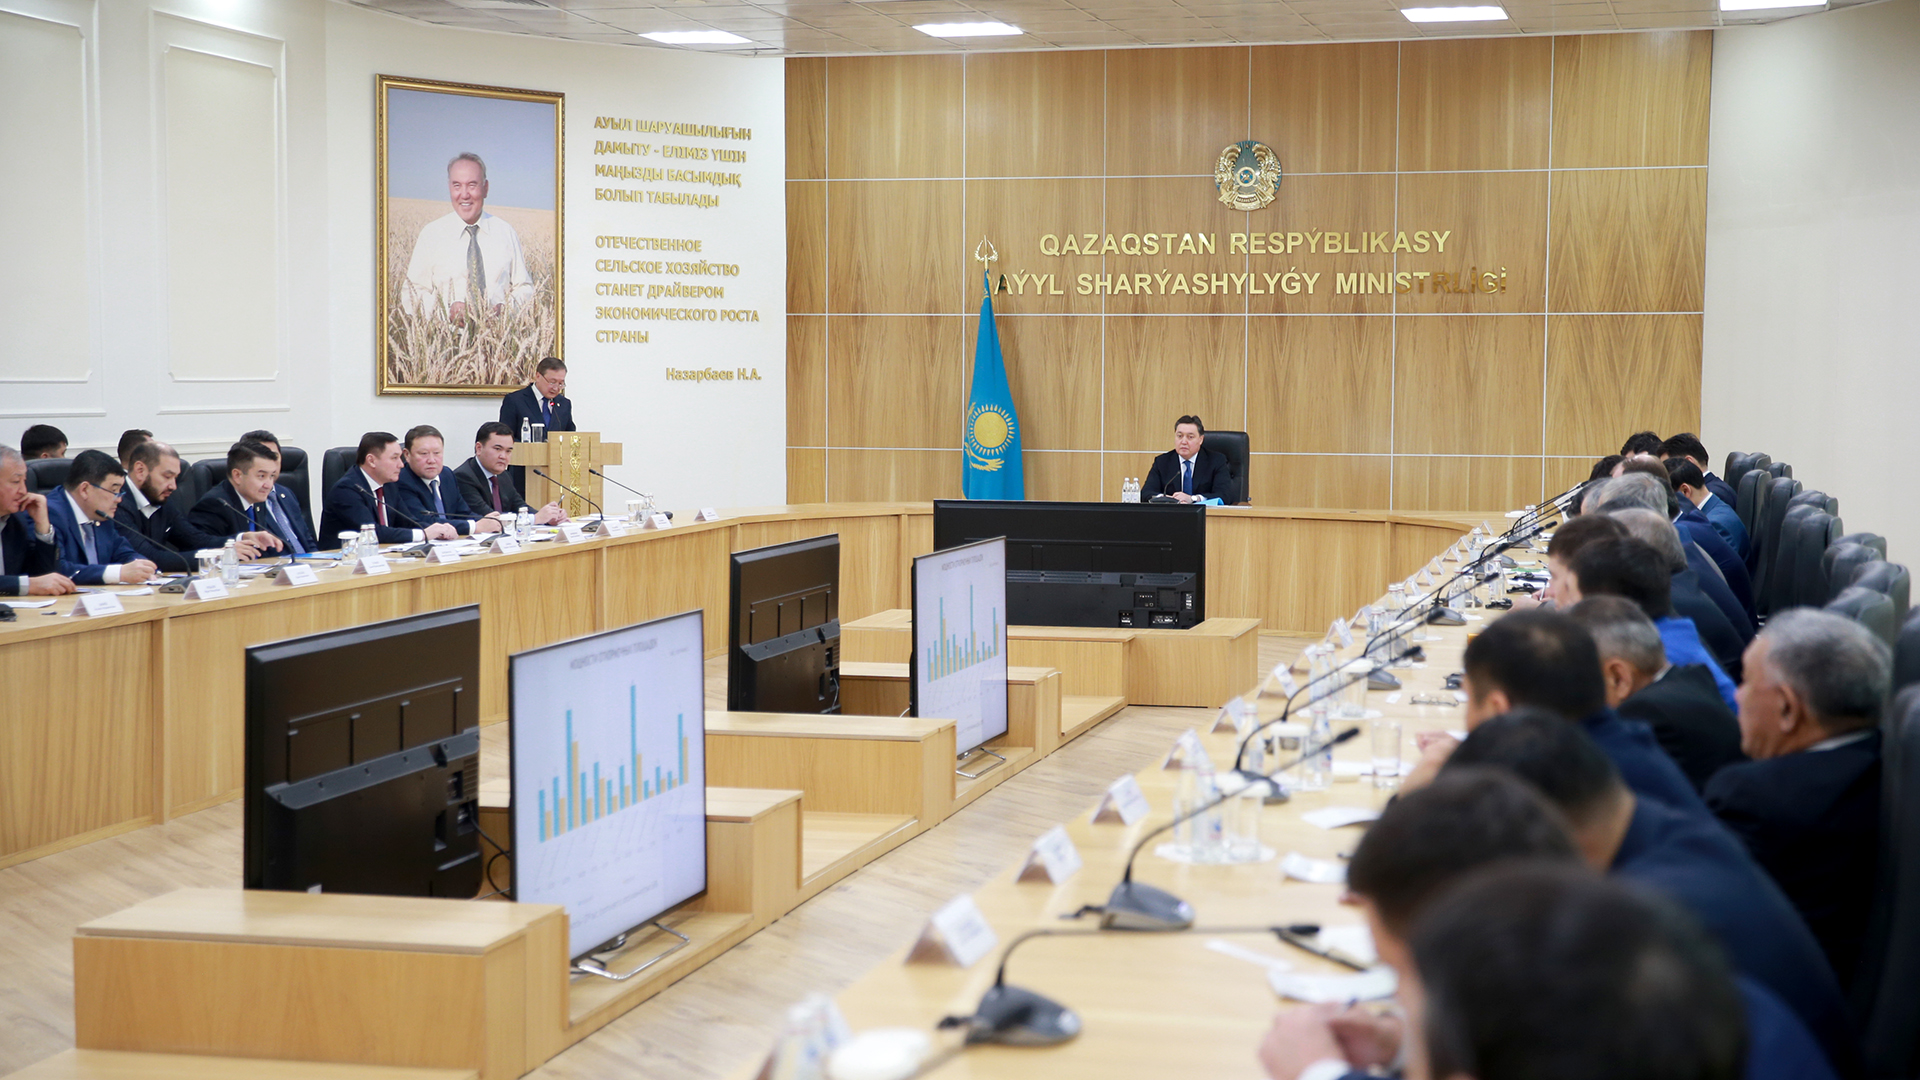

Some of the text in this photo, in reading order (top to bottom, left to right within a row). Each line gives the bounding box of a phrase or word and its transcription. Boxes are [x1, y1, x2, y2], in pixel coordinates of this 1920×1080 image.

[594, 116, 752, 140] АУЫЛ ШАРУАШЫЛЫҒЫН
[594, 140, 652, 156] ДАМЫТУ
[663, 145, 709, 160] ЕЛІМІЗ
[712, 149, 747, 163] ҮШІН
[595, 164, 742, 188] МАҢЫЗДЫ БАСЫМДЫҚ
[595, 187, 720, 209] БОЛЫП ТАБЫЛАДЫ
[596, 235, 702, 252] ОТЕЧЕСТВЕННОЕ
[1039, 227, 1451, 257] QAZAQSTAN RESPÝBLIKASY
[596, 258, 740, 277] СЕЛЬСКОЕ ХОЗЯЙСТВО
[596, 281, 725, 299] СТАНЕТ ДРАЙВЕРОМ
[994, 269, 1064, 295] AÝYL
[1076, 266, 1320, 295] SHARÝASHYLYǴY
[596, 306, 760, 322] ЭКОНОМИЧЕСКОГО РОСТА
[596, 329, 649, 343] СТРАНЫ
[666, 367, 762, 383] Назарбаев Н.А.
